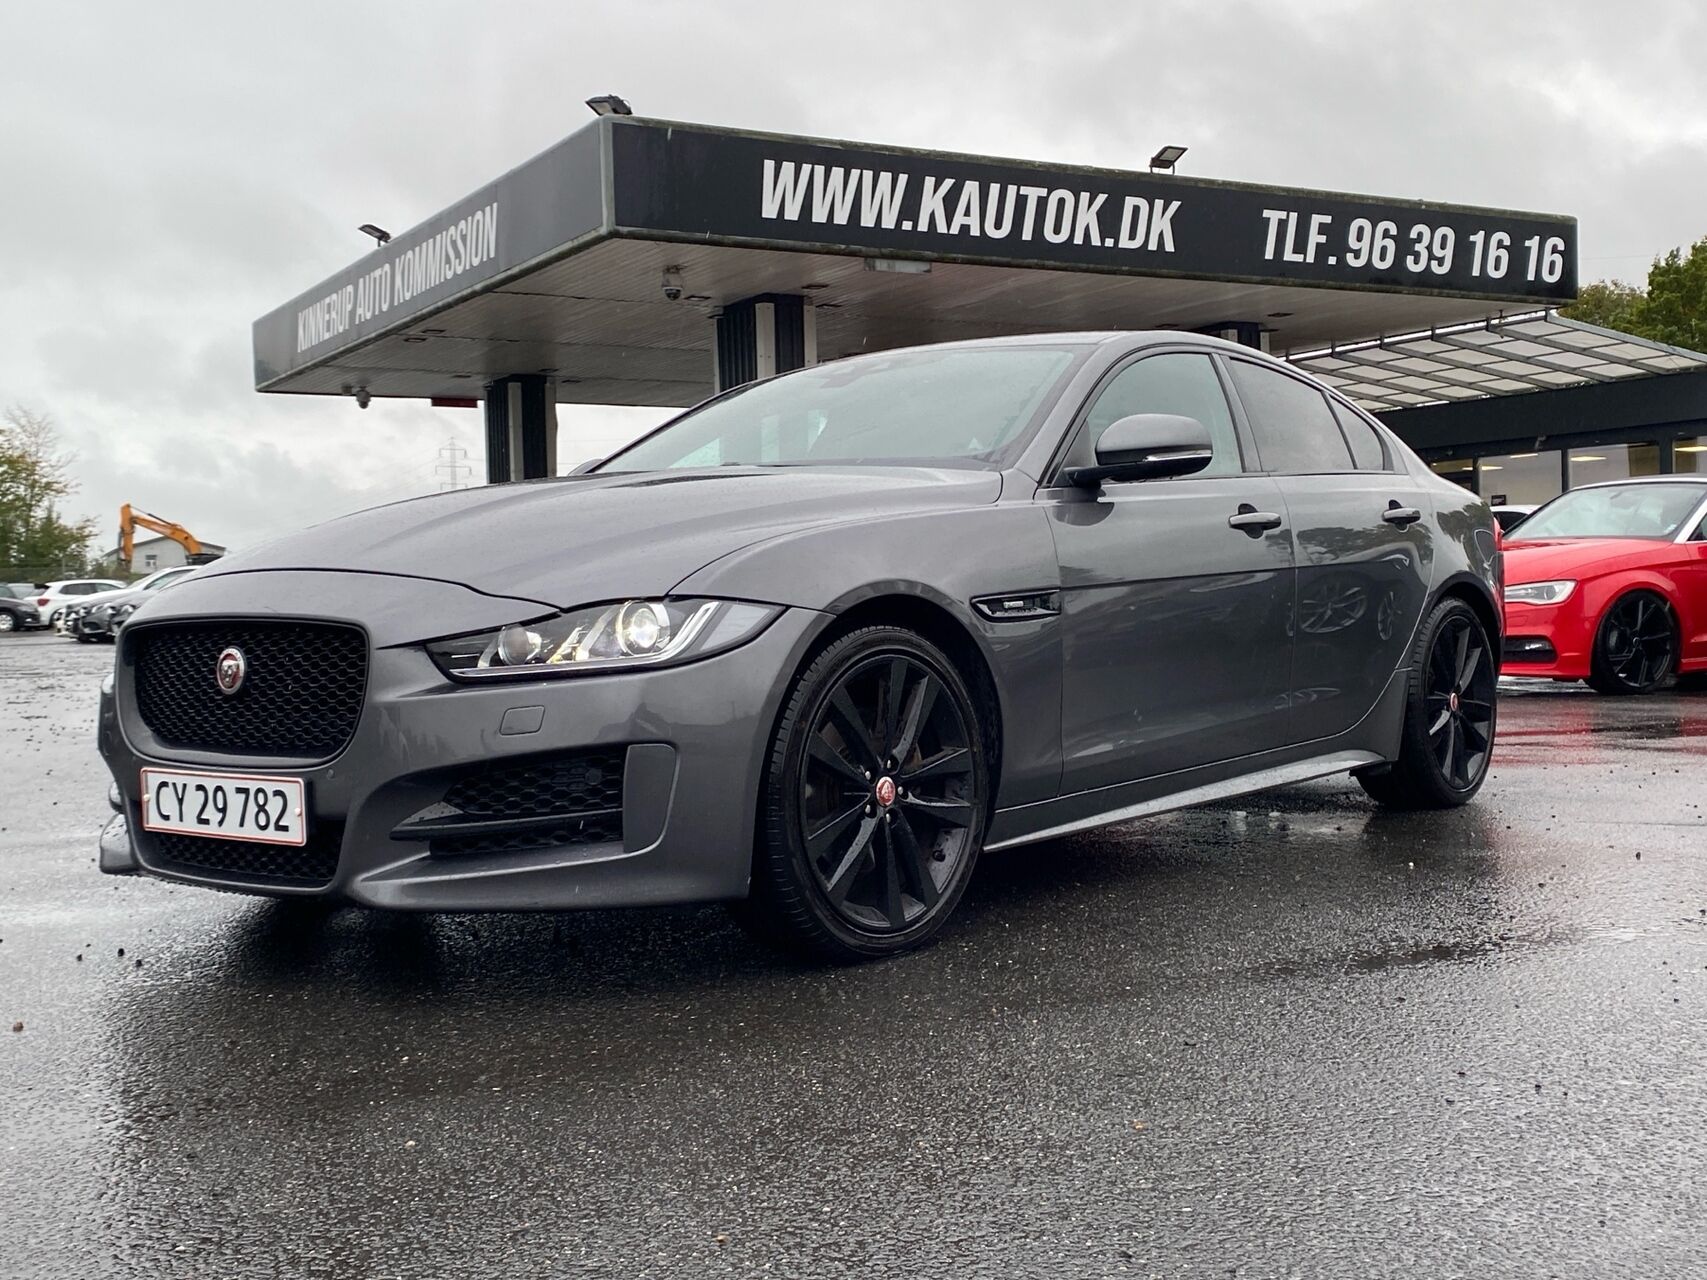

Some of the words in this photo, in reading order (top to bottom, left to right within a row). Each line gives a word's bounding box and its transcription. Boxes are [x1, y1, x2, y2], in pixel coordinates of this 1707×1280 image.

[761, 159, 1182, 253] WWW.KAUTOK.DK
[1262, 209, 1337, 265] TLF.
[1346, 218, 1398, 269] 96
[1406, 223, 1456, 275] 39
[1470, 230, 1511, 279] 16
[1524, 235, 1565, 283] 16
[297, 284, 354, 353] KINNERUP
[355, 263, 391, 325] AUTO
[394, 202, 498, 306] KOMMISSION
